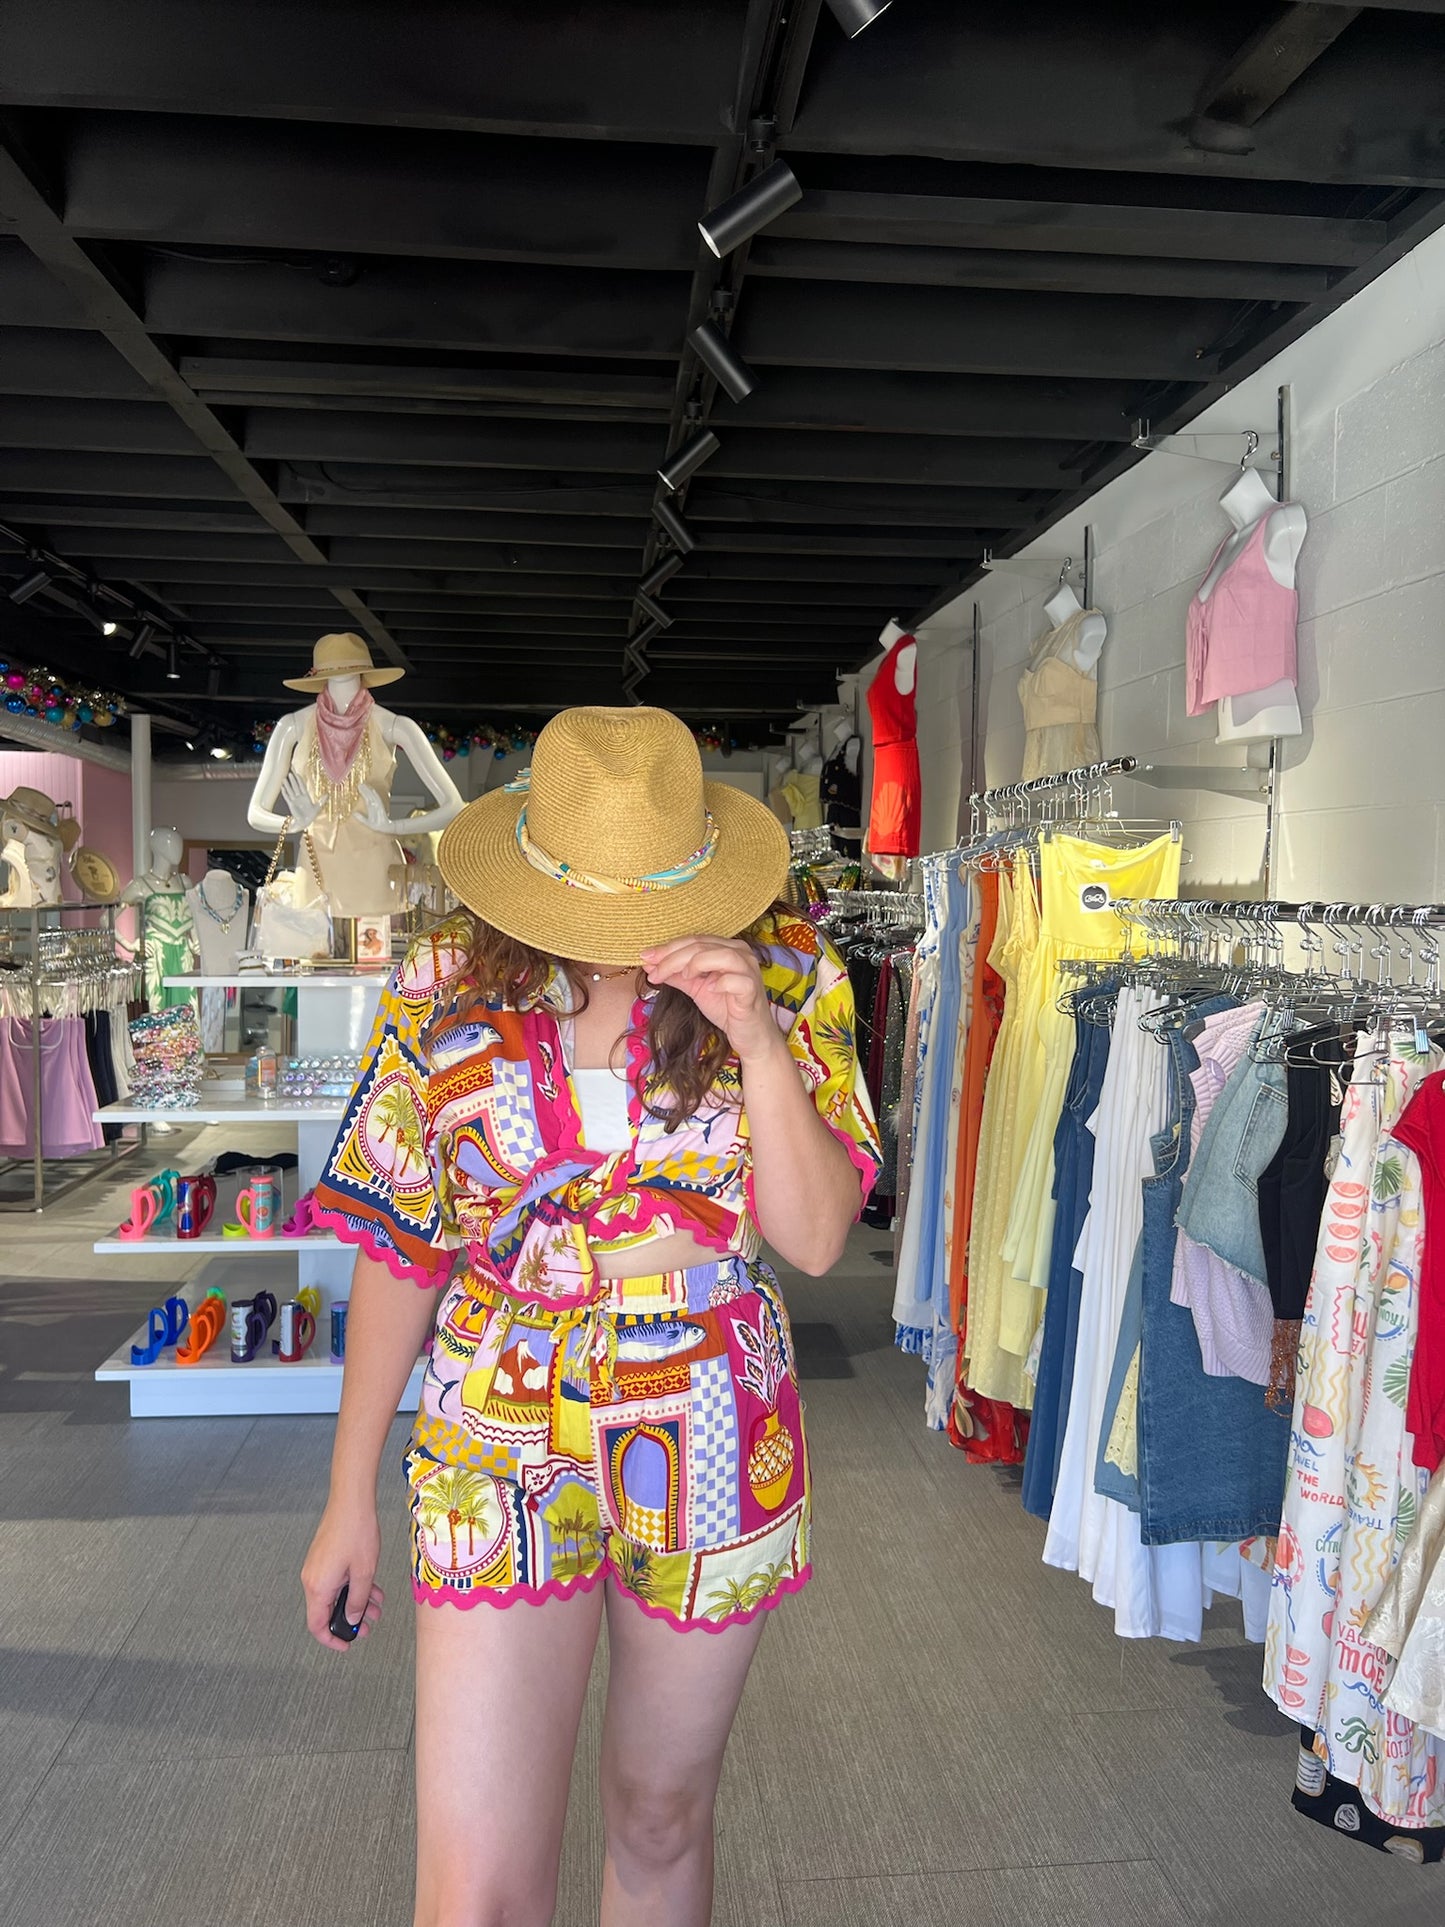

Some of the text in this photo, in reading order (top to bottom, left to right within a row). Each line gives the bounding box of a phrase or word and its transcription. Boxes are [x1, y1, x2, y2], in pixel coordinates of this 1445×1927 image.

[1296, 1469, 1319, 1487] THE
[1300, 1486, 1344, 1506] WORLD
[1347, 1504, 1384, 1531] TRAVE
[1335, 1640, 1385, 1694] MOE
